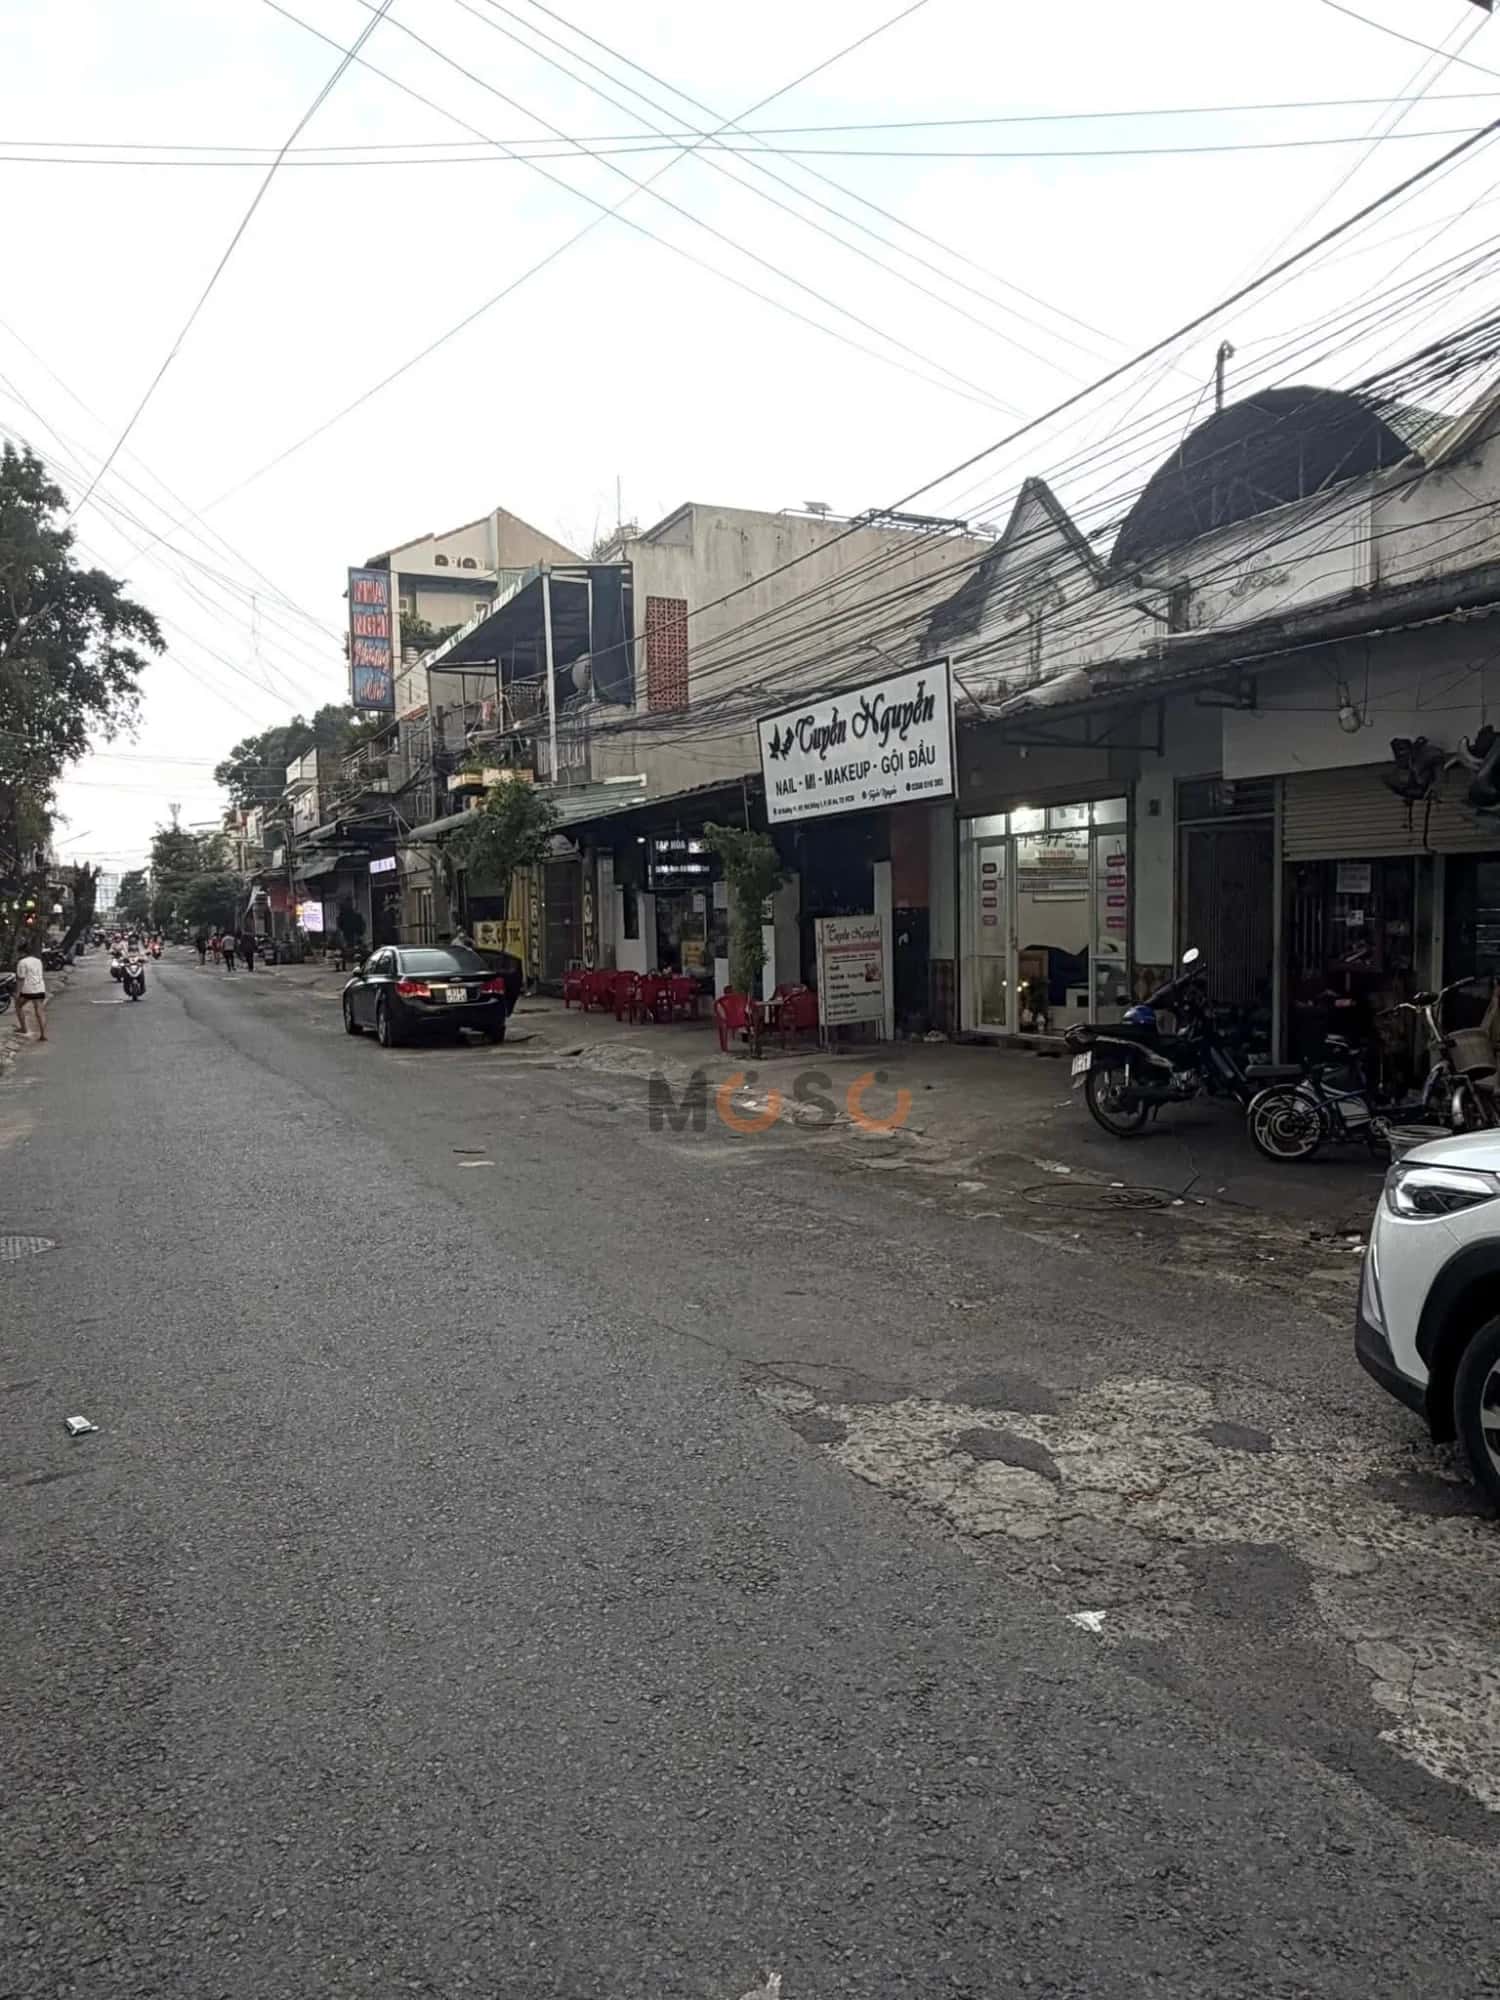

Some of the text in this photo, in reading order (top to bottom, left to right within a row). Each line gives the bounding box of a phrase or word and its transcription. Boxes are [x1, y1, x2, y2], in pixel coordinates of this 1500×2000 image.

[775, 777, 798, 797] NAIL
[804, 773, 816, 791] MI
[824, 760, 870, 786] MAKEUP
[881, 749, 904, 777] GỘI
